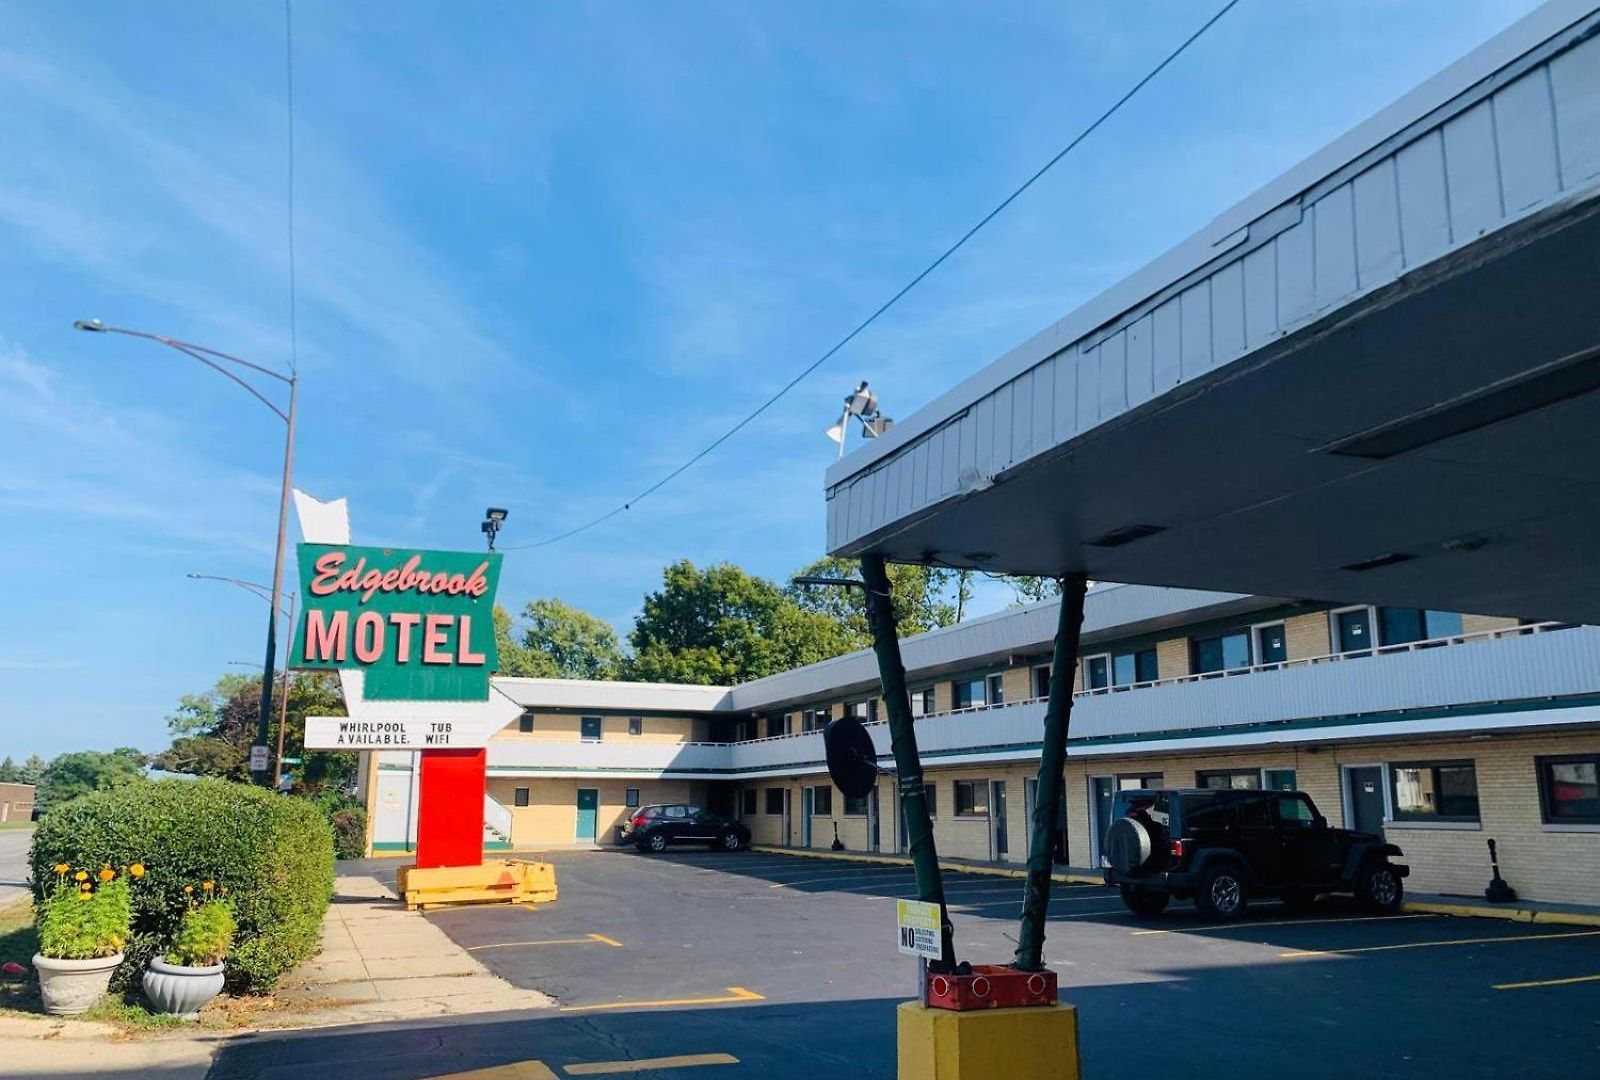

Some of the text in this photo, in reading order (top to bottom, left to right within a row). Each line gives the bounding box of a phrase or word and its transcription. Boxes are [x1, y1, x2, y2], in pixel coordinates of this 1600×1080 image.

[310, 552, 489, 602] Edgebrook
[304, 609, 486, 665] MOTEL
[339, 722, 452, 733] WHIRLPOOL TUB
[425, 734, 449, 744] WIFI
[901, 926, 915, 948] NO
